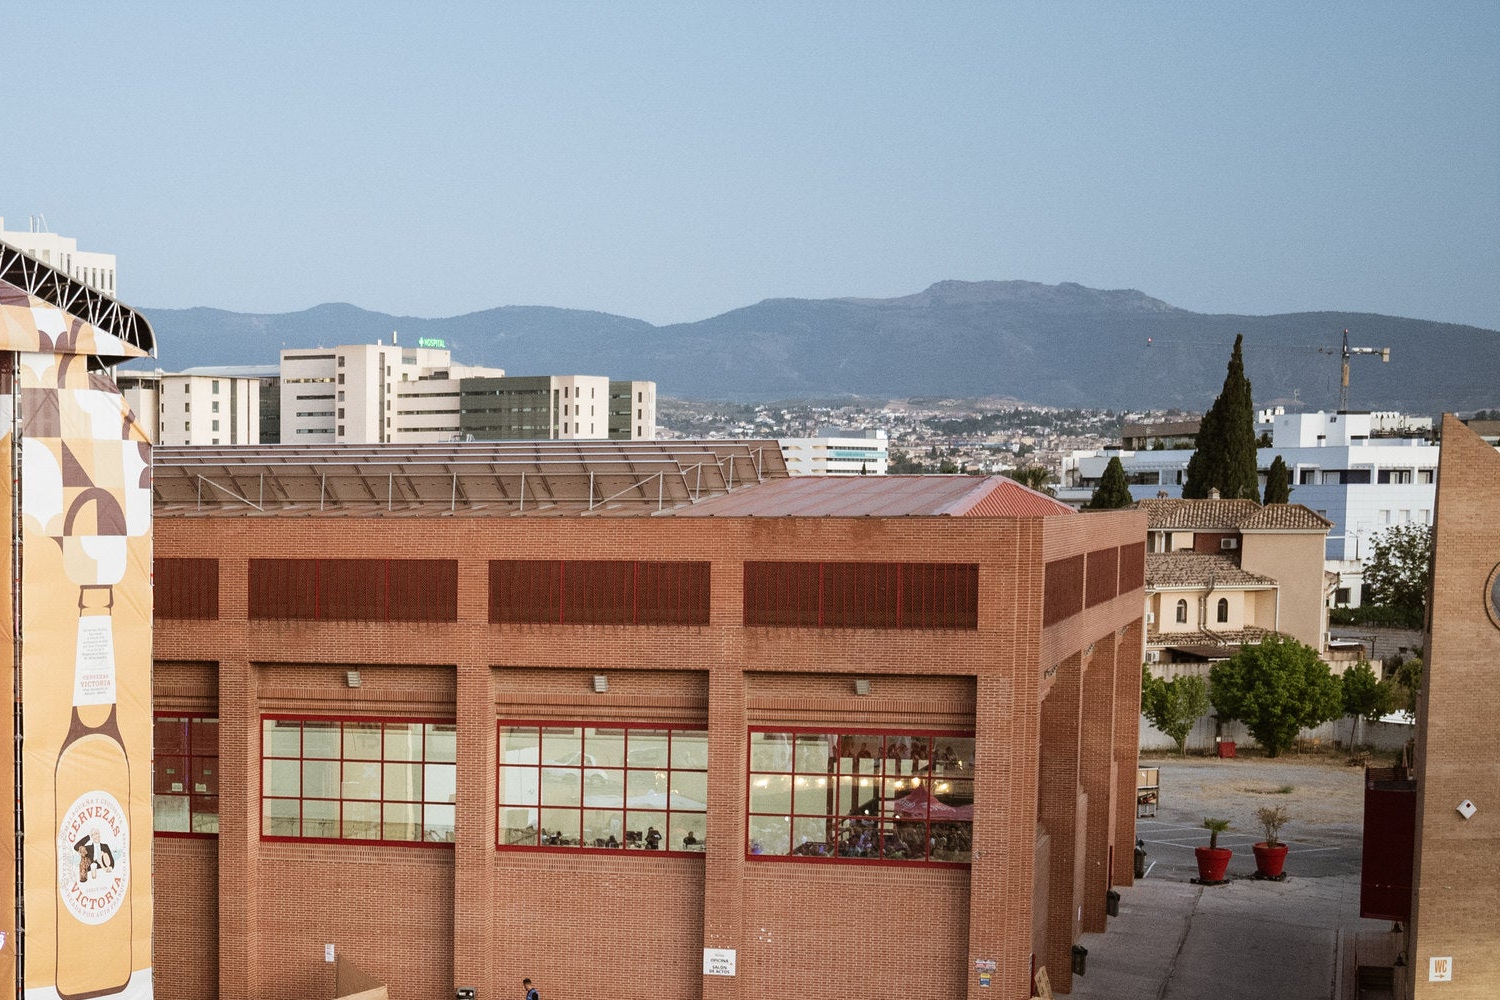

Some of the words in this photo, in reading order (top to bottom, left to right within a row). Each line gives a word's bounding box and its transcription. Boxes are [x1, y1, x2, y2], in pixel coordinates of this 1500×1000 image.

[80, 680, 111, 688] VICTORIA
[68, 806, 121, 843] CERVEZAS
[71, 876, 121, 910] VICTORIA
[1434, 959, 1448, 973] WC
